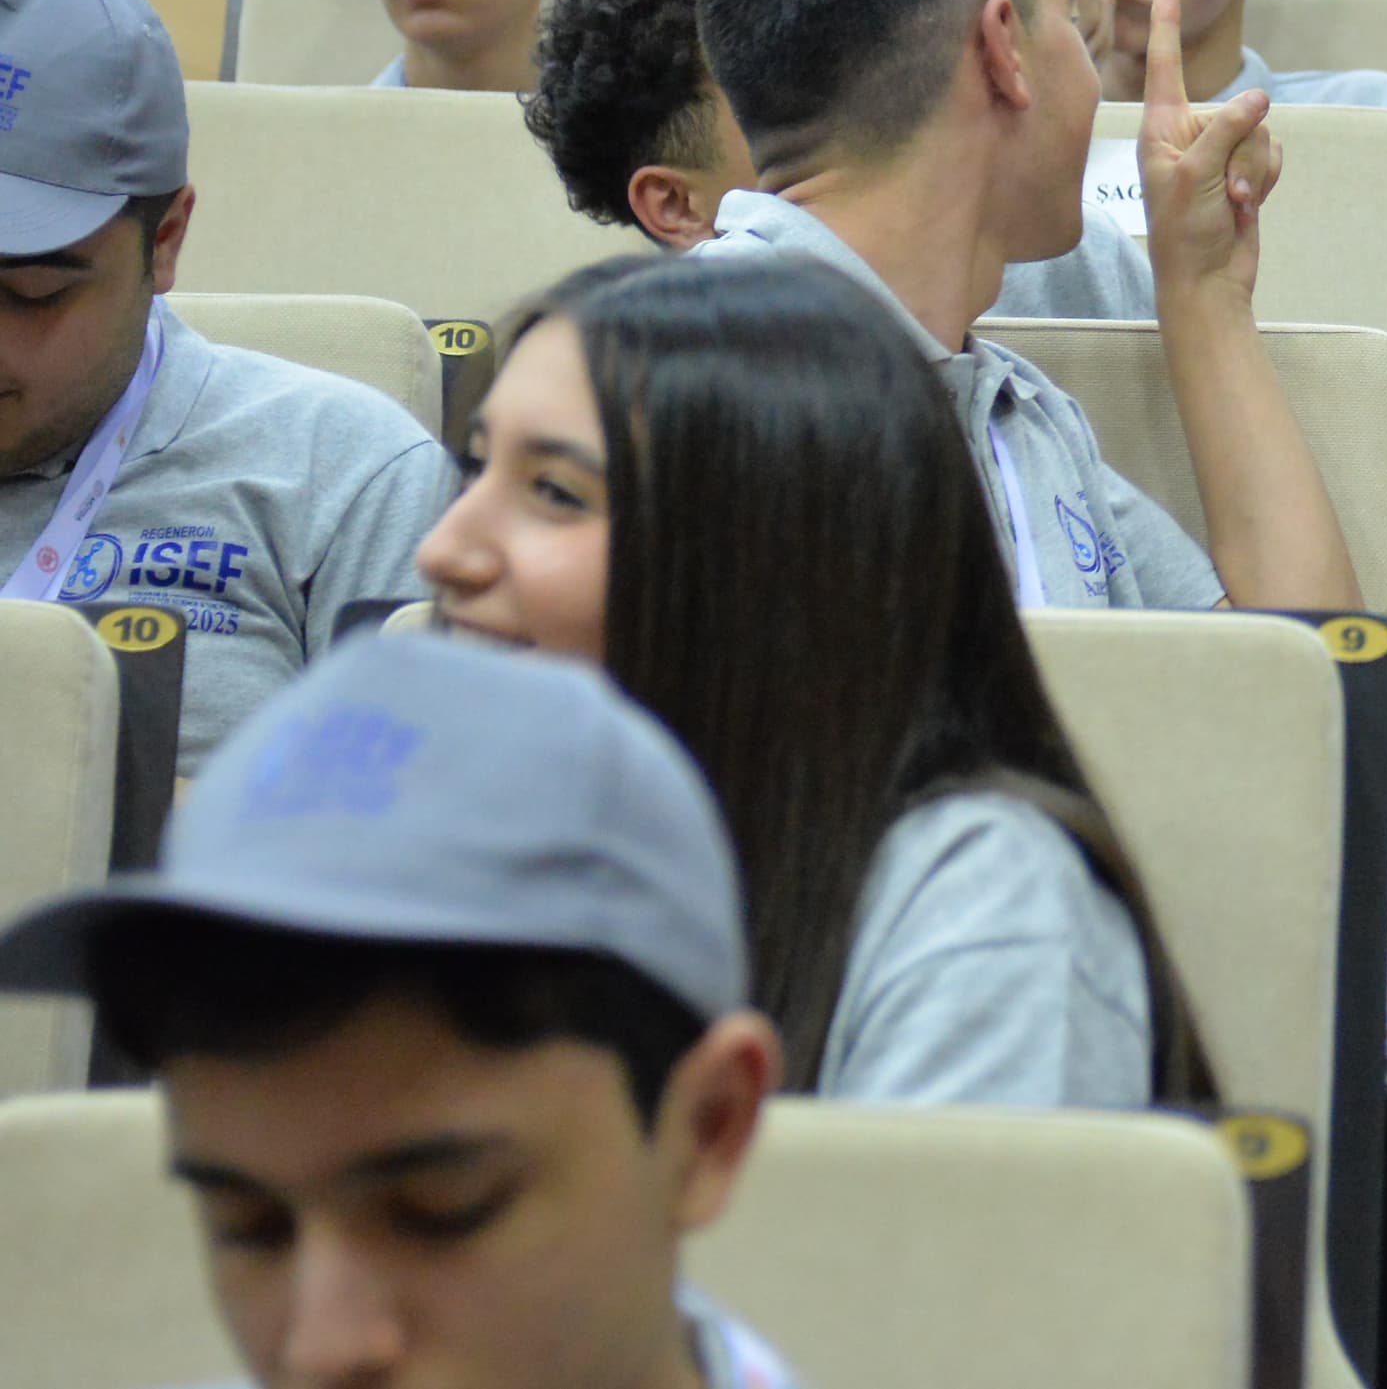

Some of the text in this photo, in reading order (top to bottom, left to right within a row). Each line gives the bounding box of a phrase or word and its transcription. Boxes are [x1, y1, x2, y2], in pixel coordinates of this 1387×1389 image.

[1096, 183, 1143, 204] ŞAG
[438, 327, 476, 349] 10
[140, 526, 215, 540] REGENERON
[129, 541, 249, 594] ISEF
[113, 615, 161, 643] 10
[187, 608, 240, 636] 2025
[1343, 626, 1367, 652] 9
